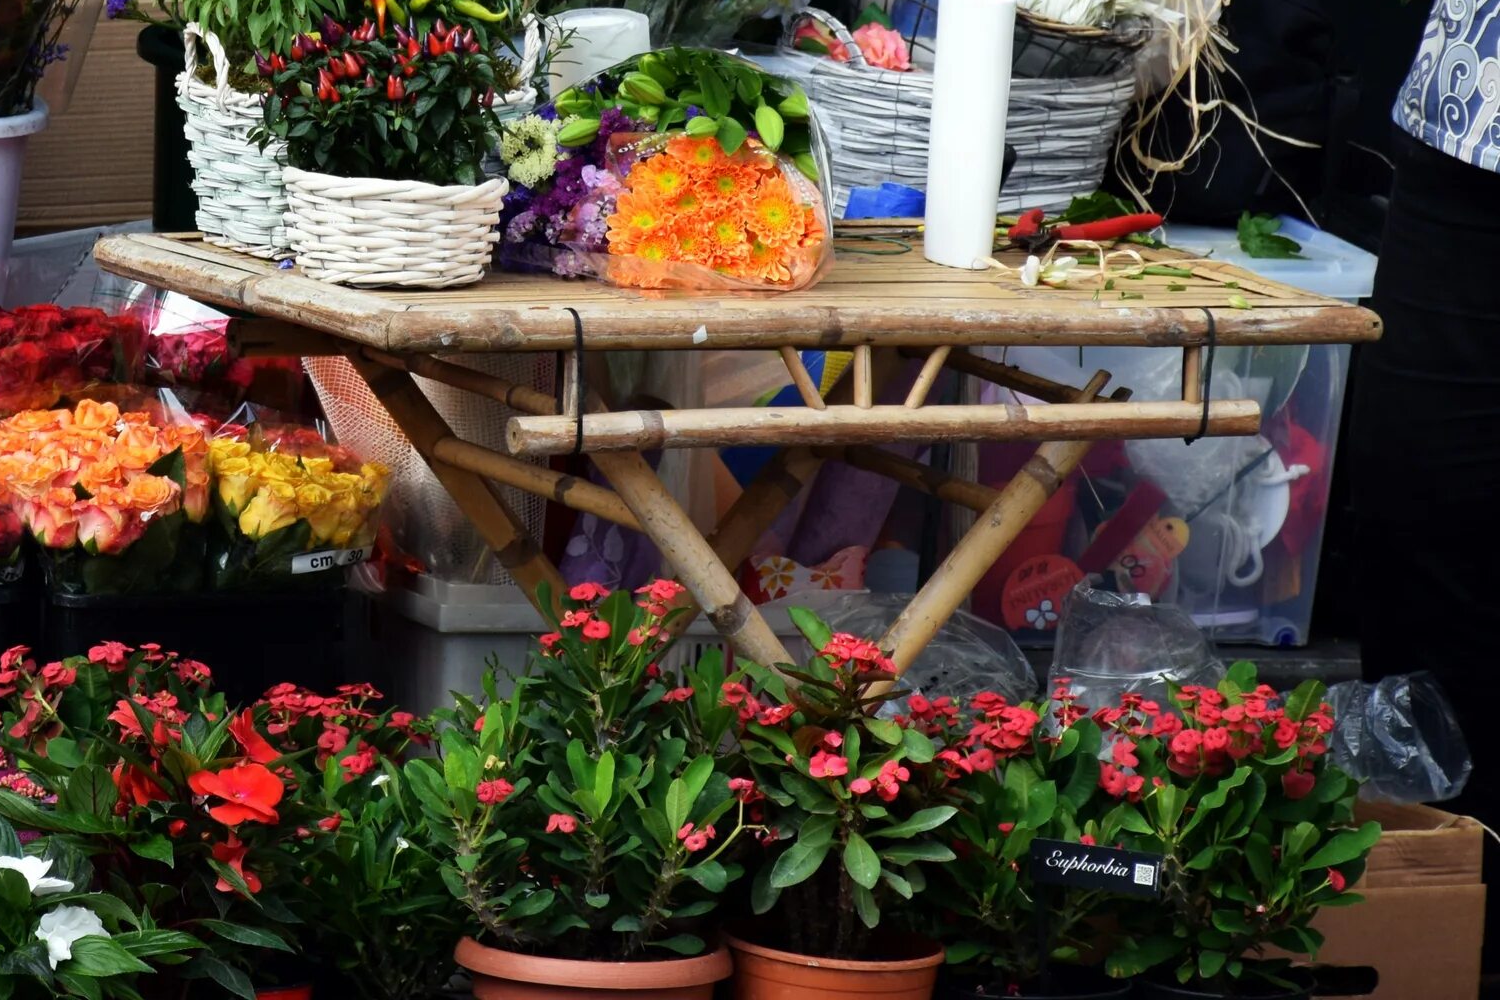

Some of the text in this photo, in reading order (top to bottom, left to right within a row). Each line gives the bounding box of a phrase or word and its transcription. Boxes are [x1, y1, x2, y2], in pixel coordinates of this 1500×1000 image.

[310, 549, 364, 569] cm 30
[1045, 849, 1130, 878] Euphorbia
